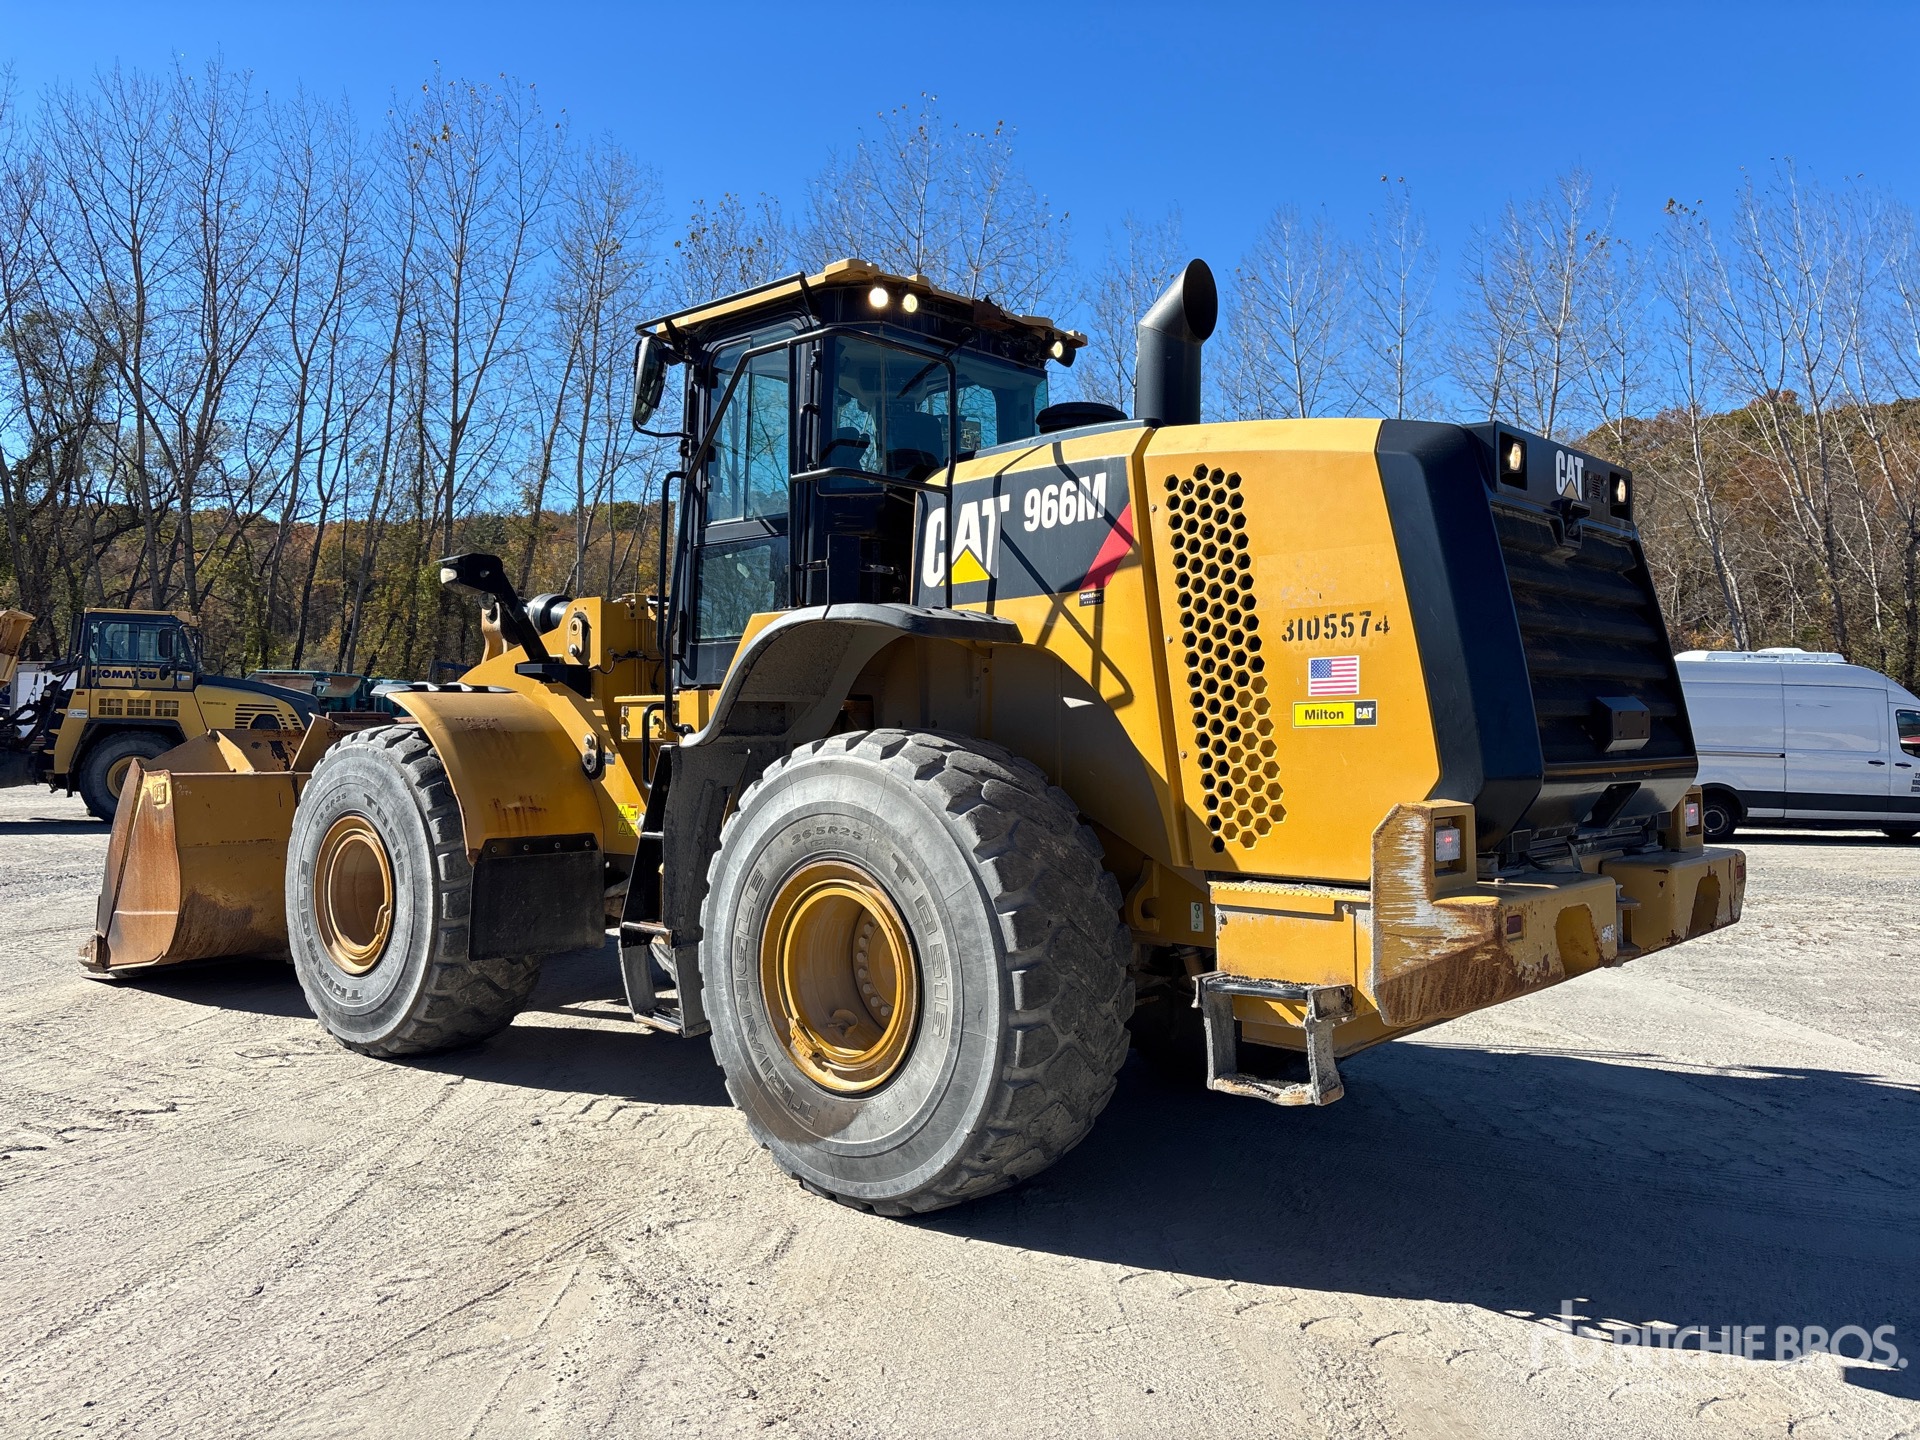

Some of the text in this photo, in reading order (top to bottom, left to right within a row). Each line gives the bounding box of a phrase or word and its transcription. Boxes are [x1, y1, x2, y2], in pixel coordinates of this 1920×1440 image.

[1023, 472, 1107, 532] 966M
[1555, 449, 1584, 502] CAT
[922, 494, 1011, 588] CAT
[91, 668, 157, 680] KOMATSU
[1304, 706, 1375, 721] Milton CAT
[791, 825, 863, 846] 26.5R25
[299, 859, 364, 1003] TRIANGLE
[734, 867, 817, 1127] TRIANGLE
